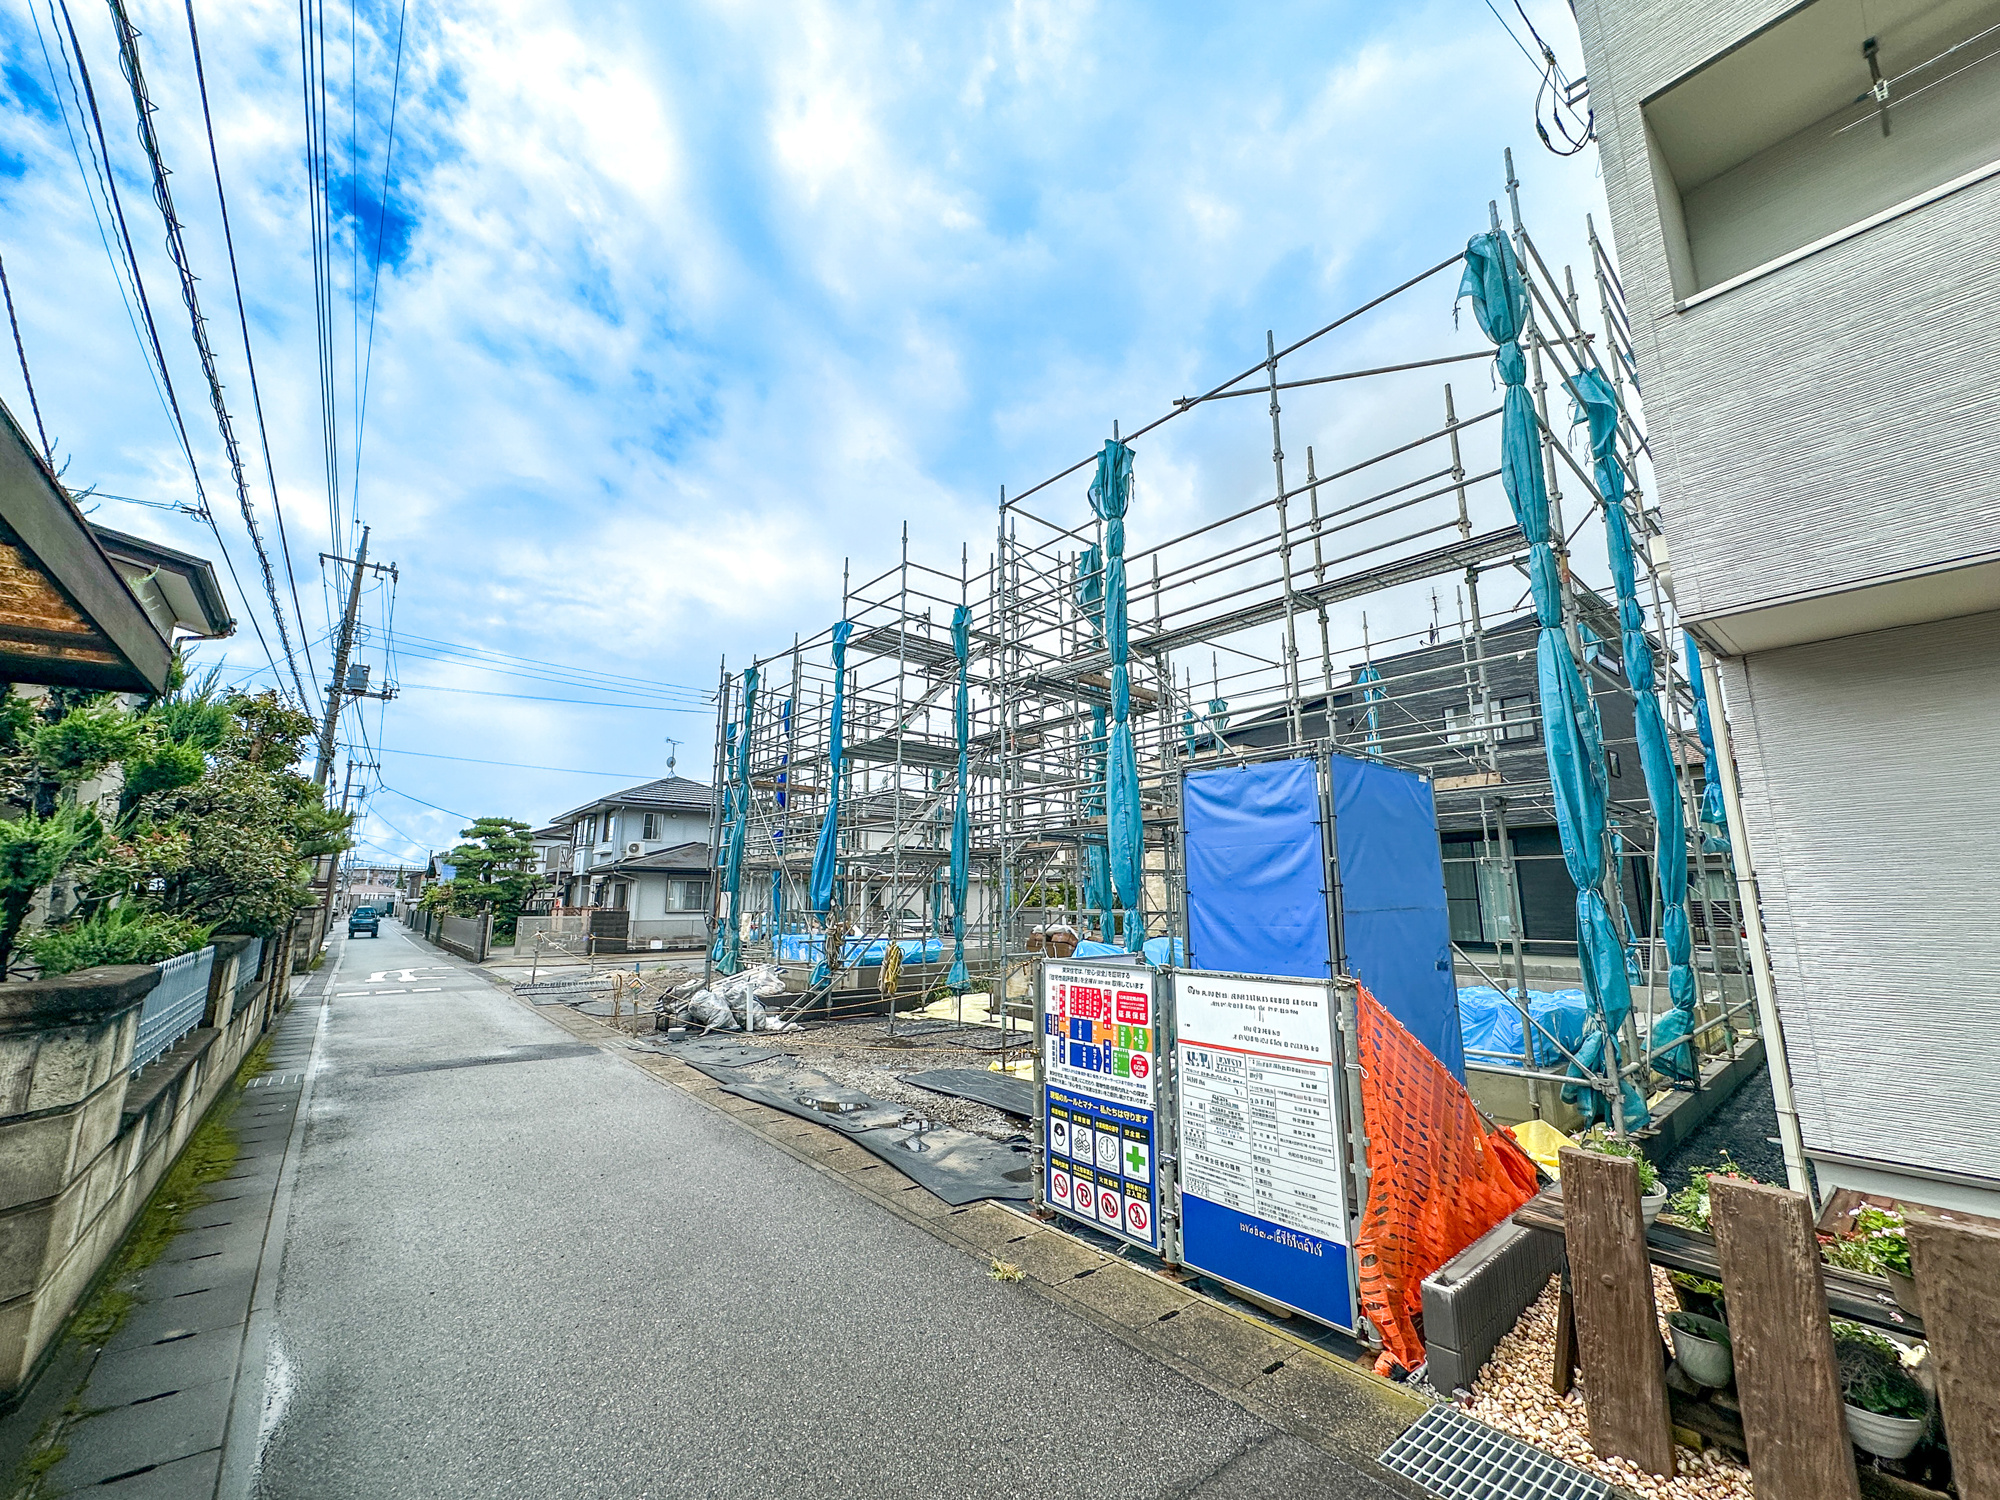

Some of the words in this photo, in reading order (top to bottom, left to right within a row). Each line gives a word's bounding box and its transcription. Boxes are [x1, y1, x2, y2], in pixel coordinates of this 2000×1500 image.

[1100, 1105, 1148, 1125] 私たちは守ります
